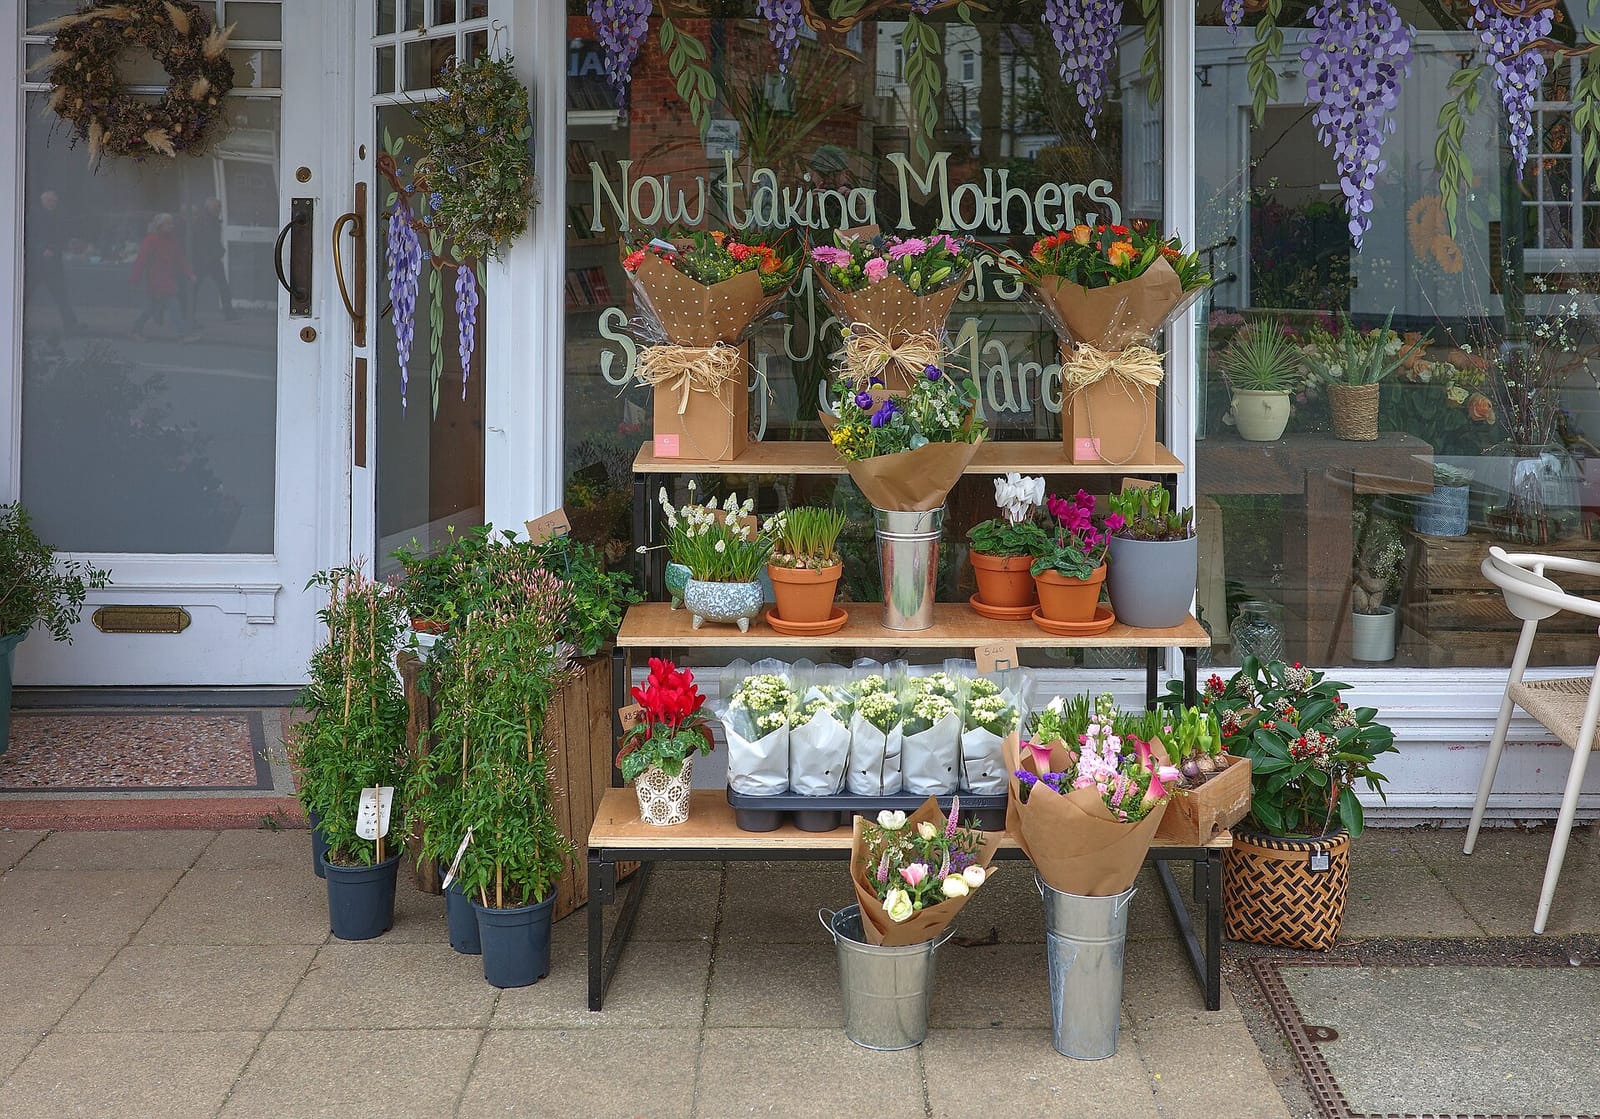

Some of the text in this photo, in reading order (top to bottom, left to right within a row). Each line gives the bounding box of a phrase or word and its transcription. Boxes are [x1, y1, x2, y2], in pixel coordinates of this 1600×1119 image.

[588, 149, 1122, 236] Now taking Mothers
